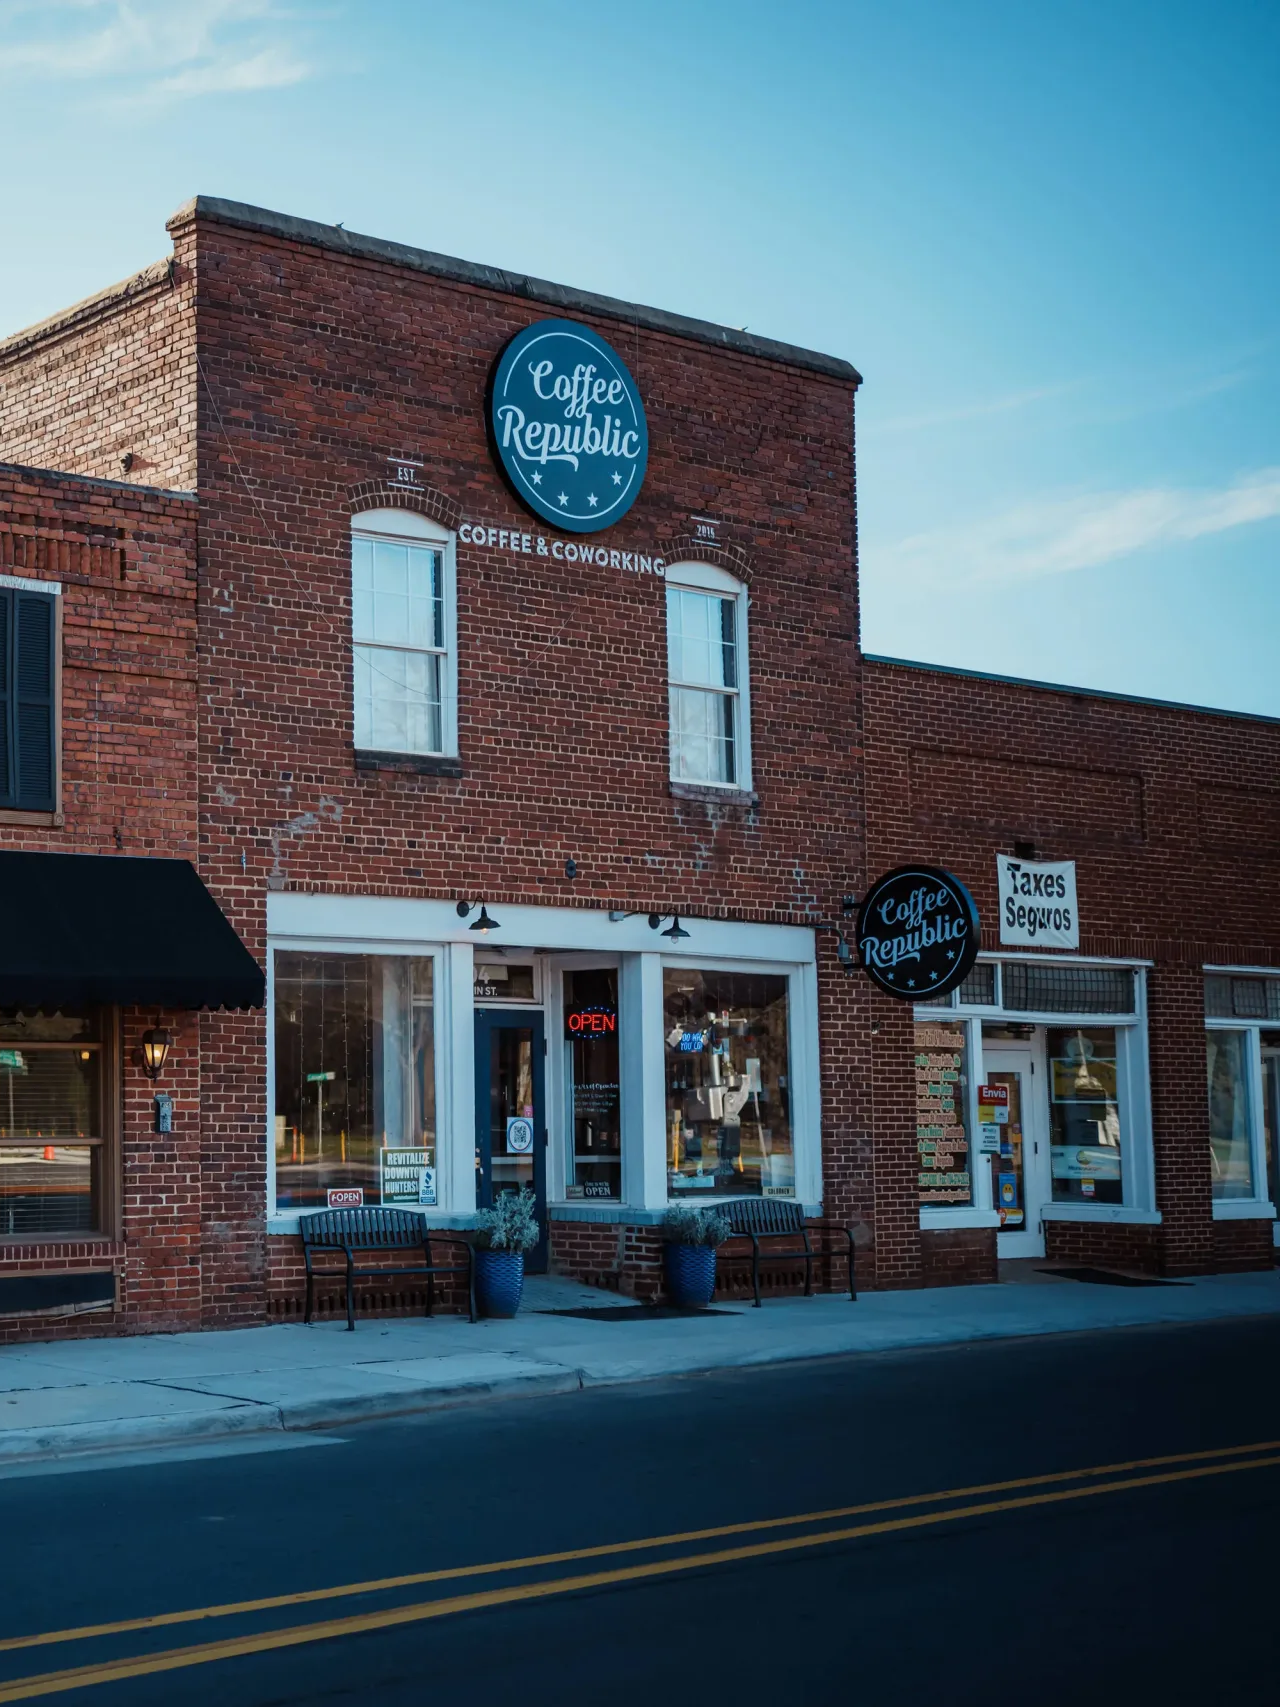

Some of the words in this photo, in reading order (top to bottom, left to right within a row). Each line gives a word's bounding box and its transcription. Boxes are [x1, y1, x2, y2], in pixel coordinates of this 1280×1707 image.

[528, 360, 624, 418] Coffee
[498, 404, 641, 471] Republic
[398, 467, 418, 483] EST.
[459, 522, 531, 553] COFFEE
[536, 538, 549, 557] &
[551, 541, 665, 577] COWORKING
[1006, 862, 1066, 898] Taxes
[877, 886, 951, 930] Coffee
[1005, 896, 1072, 937] Seguros
[860, 915, 968, 968] Republic
[485, 986, 498, 996] ST.
[568, 1013, 616, 1031] OPEN
[983, 1087, 1007, 1099] Envía
[387, 1152, 431, 1165] REVITALIZE
[336, 1193, 360, 1202] OPEN
[585, 1187, 611, 1196] OPEN
